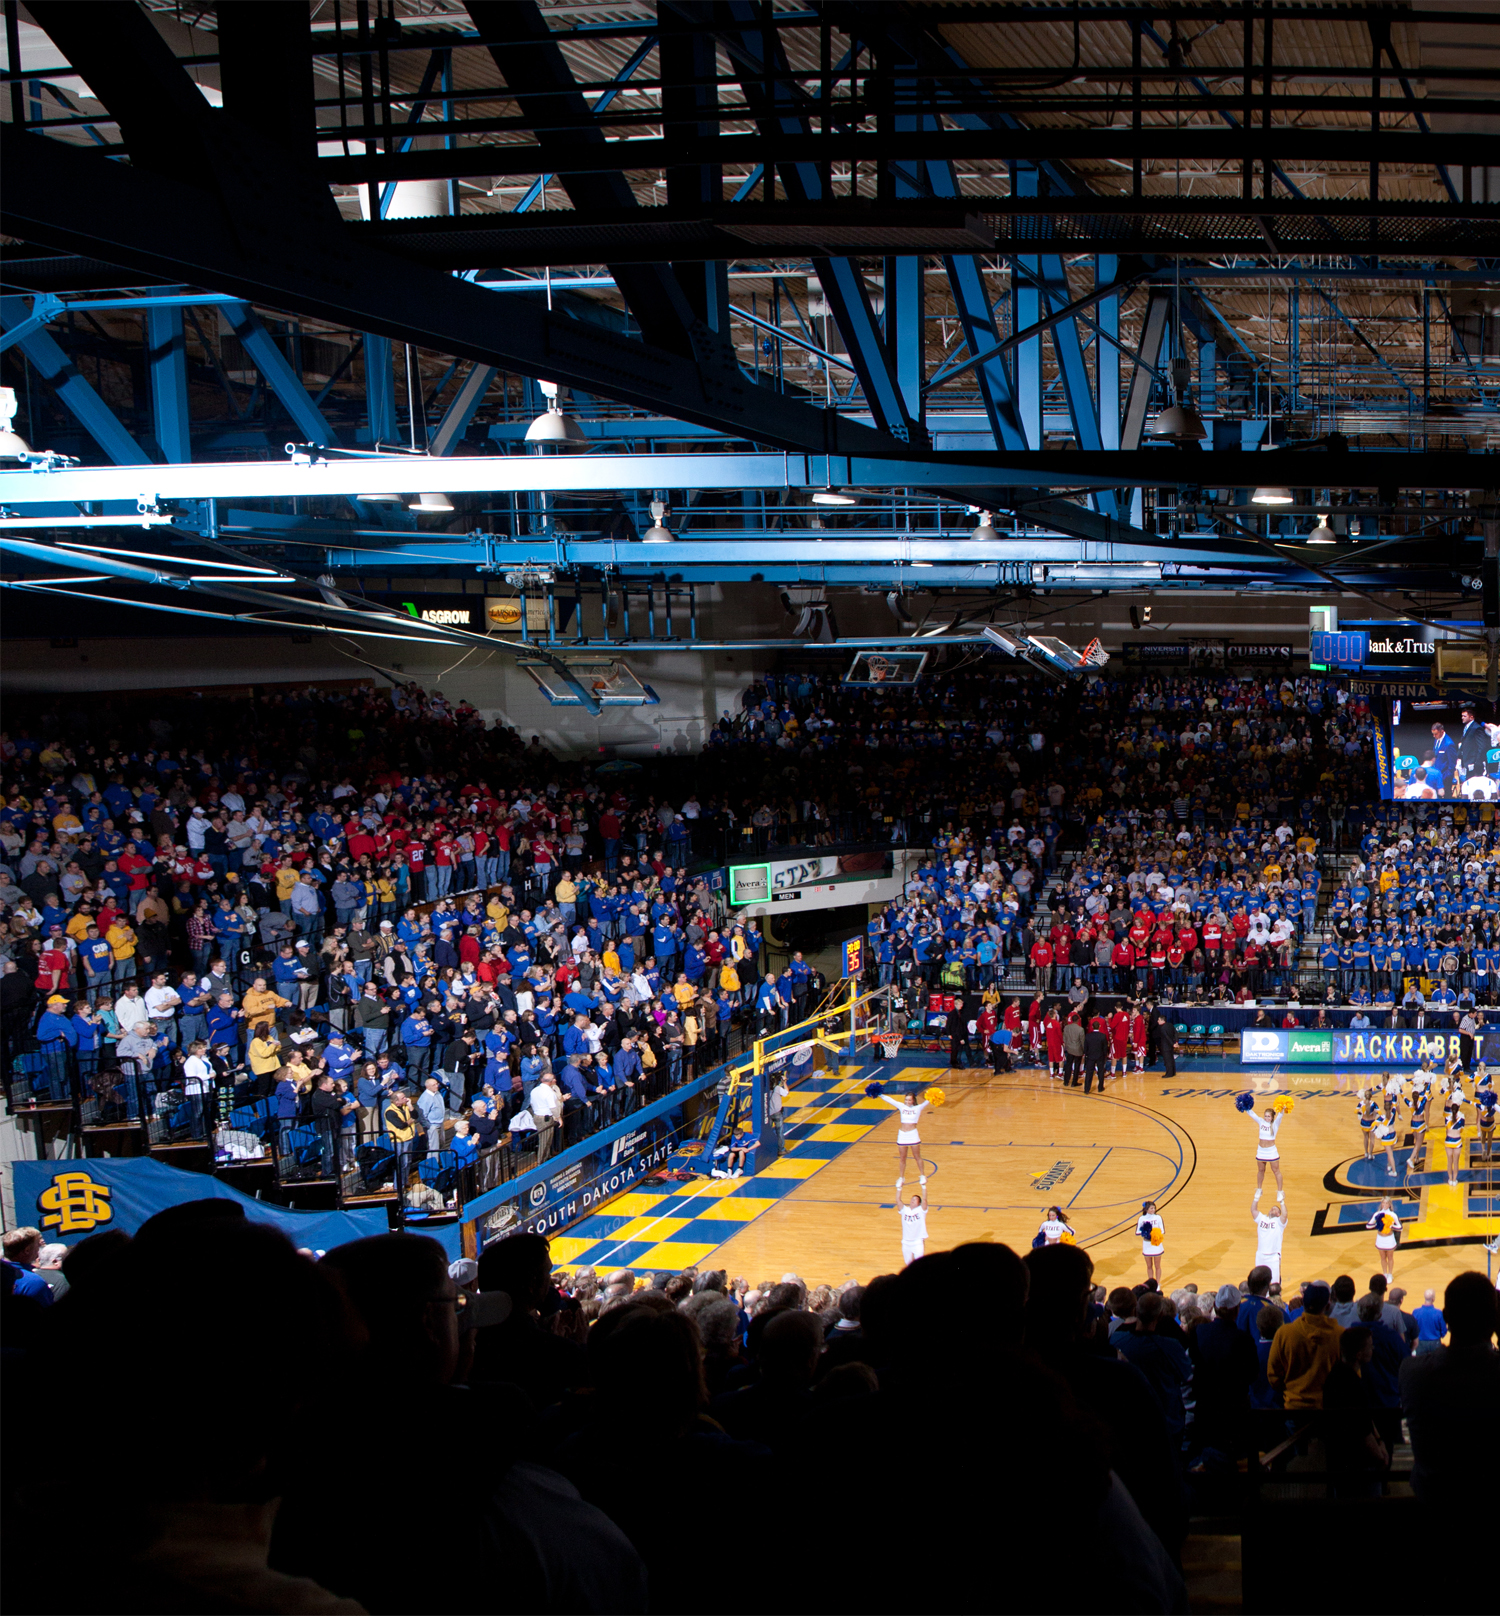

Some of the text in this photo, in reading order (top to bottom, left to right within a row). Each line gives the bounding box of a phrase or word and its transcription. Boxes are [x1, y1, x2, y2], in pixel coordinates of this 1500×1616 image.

[421, 609, 470, 625] ASGROW
[1227, 646, 1290, 660] CUBBY'S
[1313, 634, 1362, 662] 20:00
[1404, 638, 1434, 654] Trus
[1350, 682, 1428, 697] FROST ARENA
[411, 850, 424, 862] 20
[736, 881, 760, 889] Avera
[241, 950, 250, 965] G
[848, 951, 859, 972] 35
[1291, 1041, 1321, 1052] Avera
[1340, 1034, 1484, 1060] JACKRABBT
[640, 1141, 673, 1174] STATE
[1036, 1160, 1073, 1191] SUMMIT
[583, 1166, 635, 1208] DAKOTA
[527, 1200, 577, 1235] SOUTH
[904, 1212, 920, 1222] STATE
[1260, 1220, 1276, 1230] STATE
